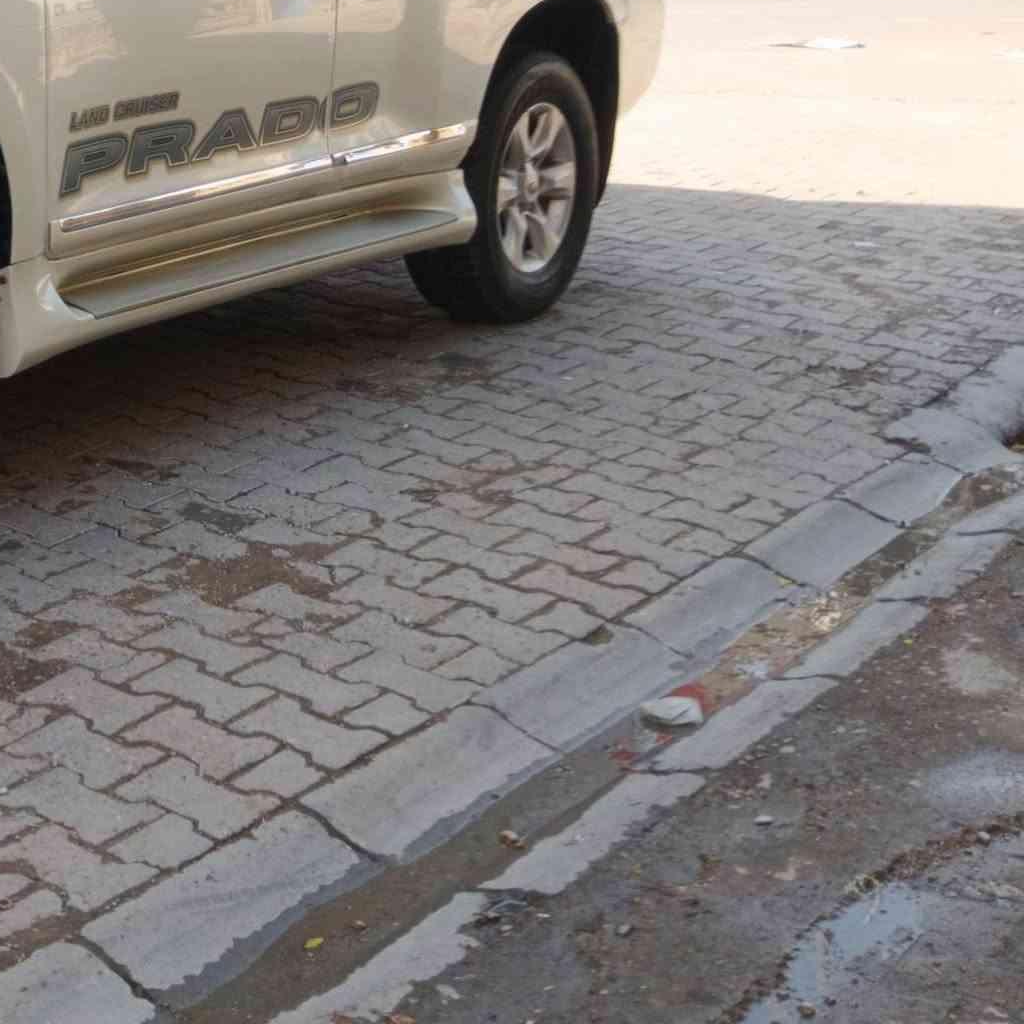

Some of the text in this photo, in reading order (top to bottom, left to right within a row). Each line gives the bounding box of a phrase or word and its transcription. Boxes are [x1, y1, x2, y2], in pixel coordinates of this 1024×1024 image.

[59, 80, 380, 201] PRADO
[69, 91, 180, 133] LAND CRUISER
